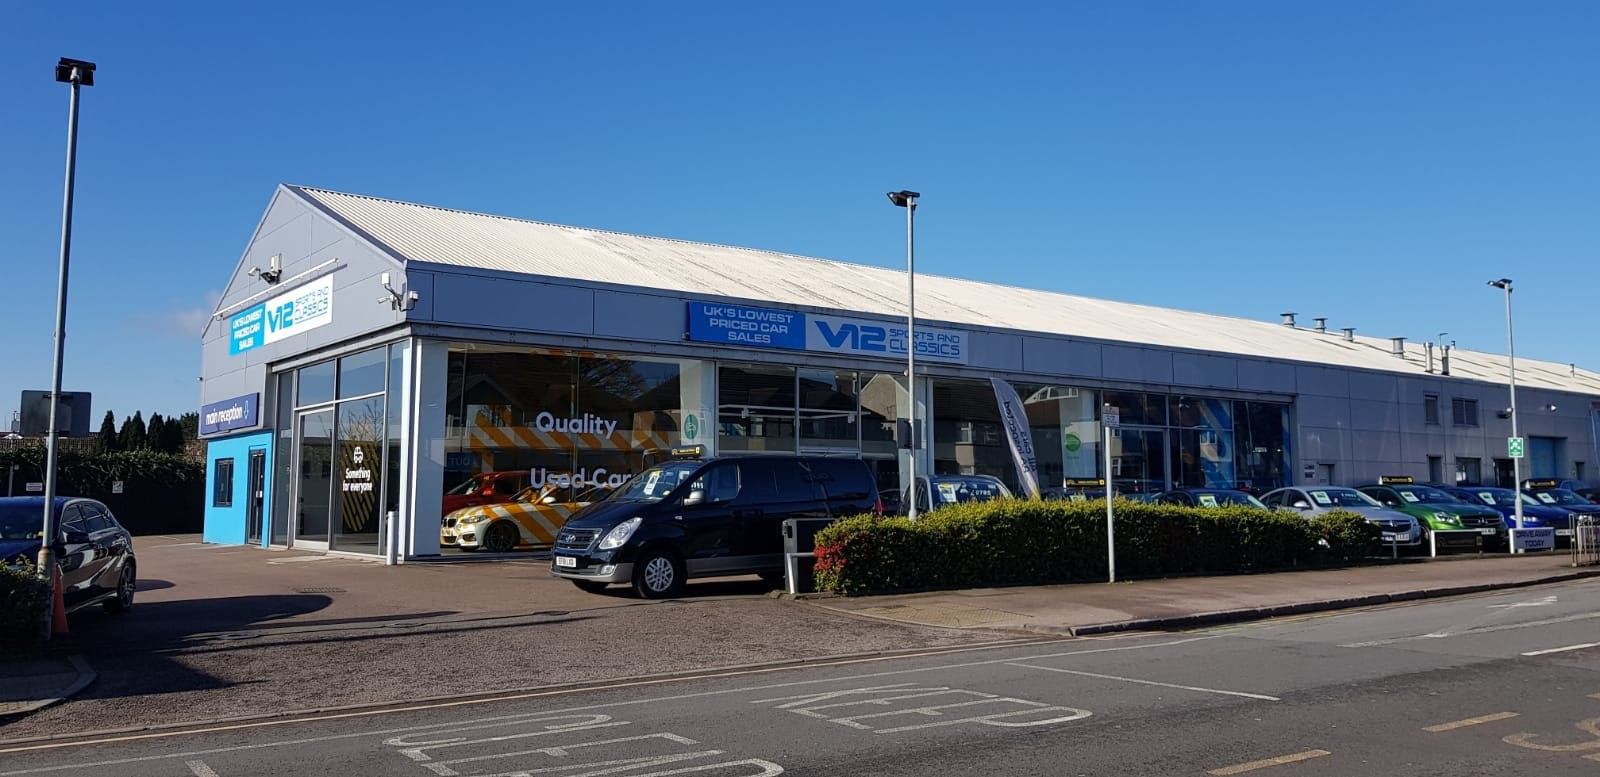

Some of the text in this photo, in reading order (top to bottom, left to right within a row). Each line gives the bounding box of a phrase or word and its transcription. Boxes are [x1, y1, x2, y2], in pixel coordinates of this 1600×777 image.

[267, 301, 294, 333] V12
[703, 306, 793, 324] UK'S LOWEST
[710, 318, 788, 334] PRICED CAR
[239, 337, 254, 350] SALES
[728, 331, 771, 343] SALES
[814, 320, 886, 352] V12
[889, 328, 960, 343] SPORTS AND
[889, 338, 960, 355] CLASSICS
[206, 402, 243, 425] main reception
[536, 411, 617, 440] Quality
[345, 467, 371, 482] Something
[530, 468, 588, 489] Used
[592, 468, 637, 489] Car
[350, 482, 373, 494] everyone
[1524, 539, 1546, 548] TODAY
[749, 683, 1093, 734] KEEP
